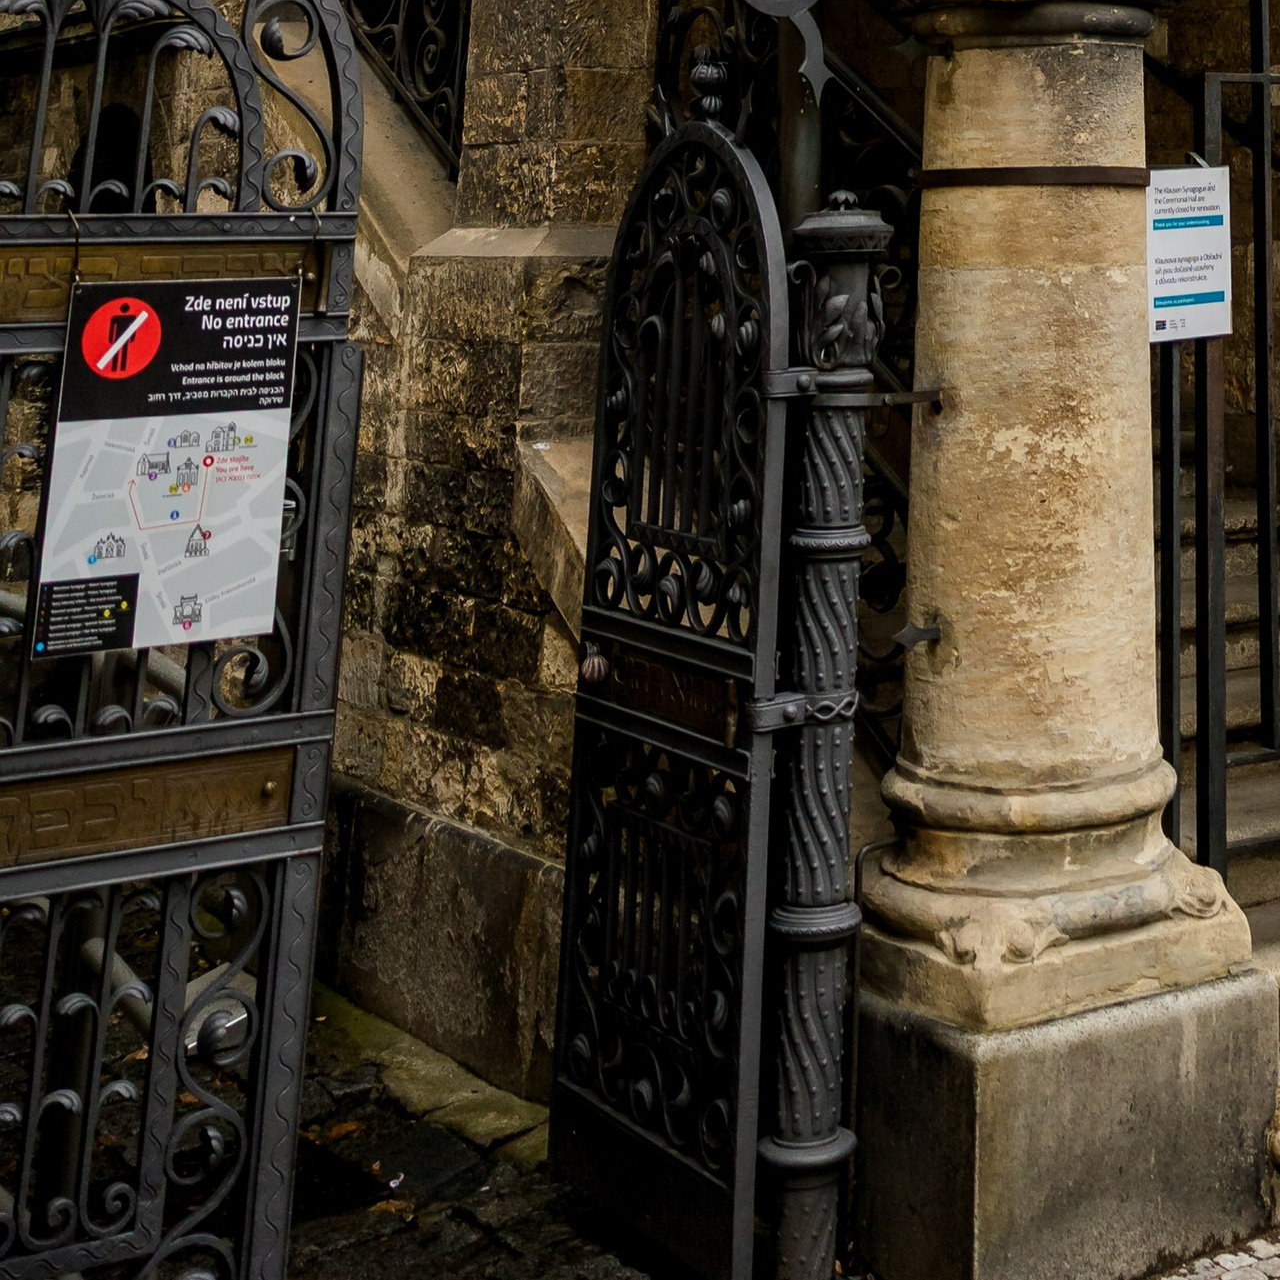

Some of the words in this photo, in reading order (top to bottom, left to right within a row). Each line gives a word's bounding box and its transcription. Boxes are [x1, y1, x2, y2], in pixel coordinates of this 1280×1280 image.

[1182, 185, 1206, 194] Synagogue
[1163, 196, 1187, 204] Ceremonial
[1154, 206, 1174, 215] currently
[1175, 205, 1189, 213] closed
[185, 295, 212, 311] Zde
[216, 293, 249, 310] není
[251, 294, 290, 311] vstup
[202, 315, 222, 330] No
[226, 314, 289, 328] entrance
[223, 335, 264, 349] כניסה
[268, 333, 287, 349] אין
[171, 362, 194, 372] Vchod
[206, 360, 232, 370] hřbitov
[233, 359, 241, 370] je
[242, 359, 264, 368] kolem
[266, 357, 286, 367] bloku
[182, 376, 215, 385] Entrance
[216, 374, 223, 383] is
[224, 373, 251, 383] around
[252, 371, 264, 381] the
[266, 371, 285, 380] block
[258, 386, 285, 395] הכניסה
